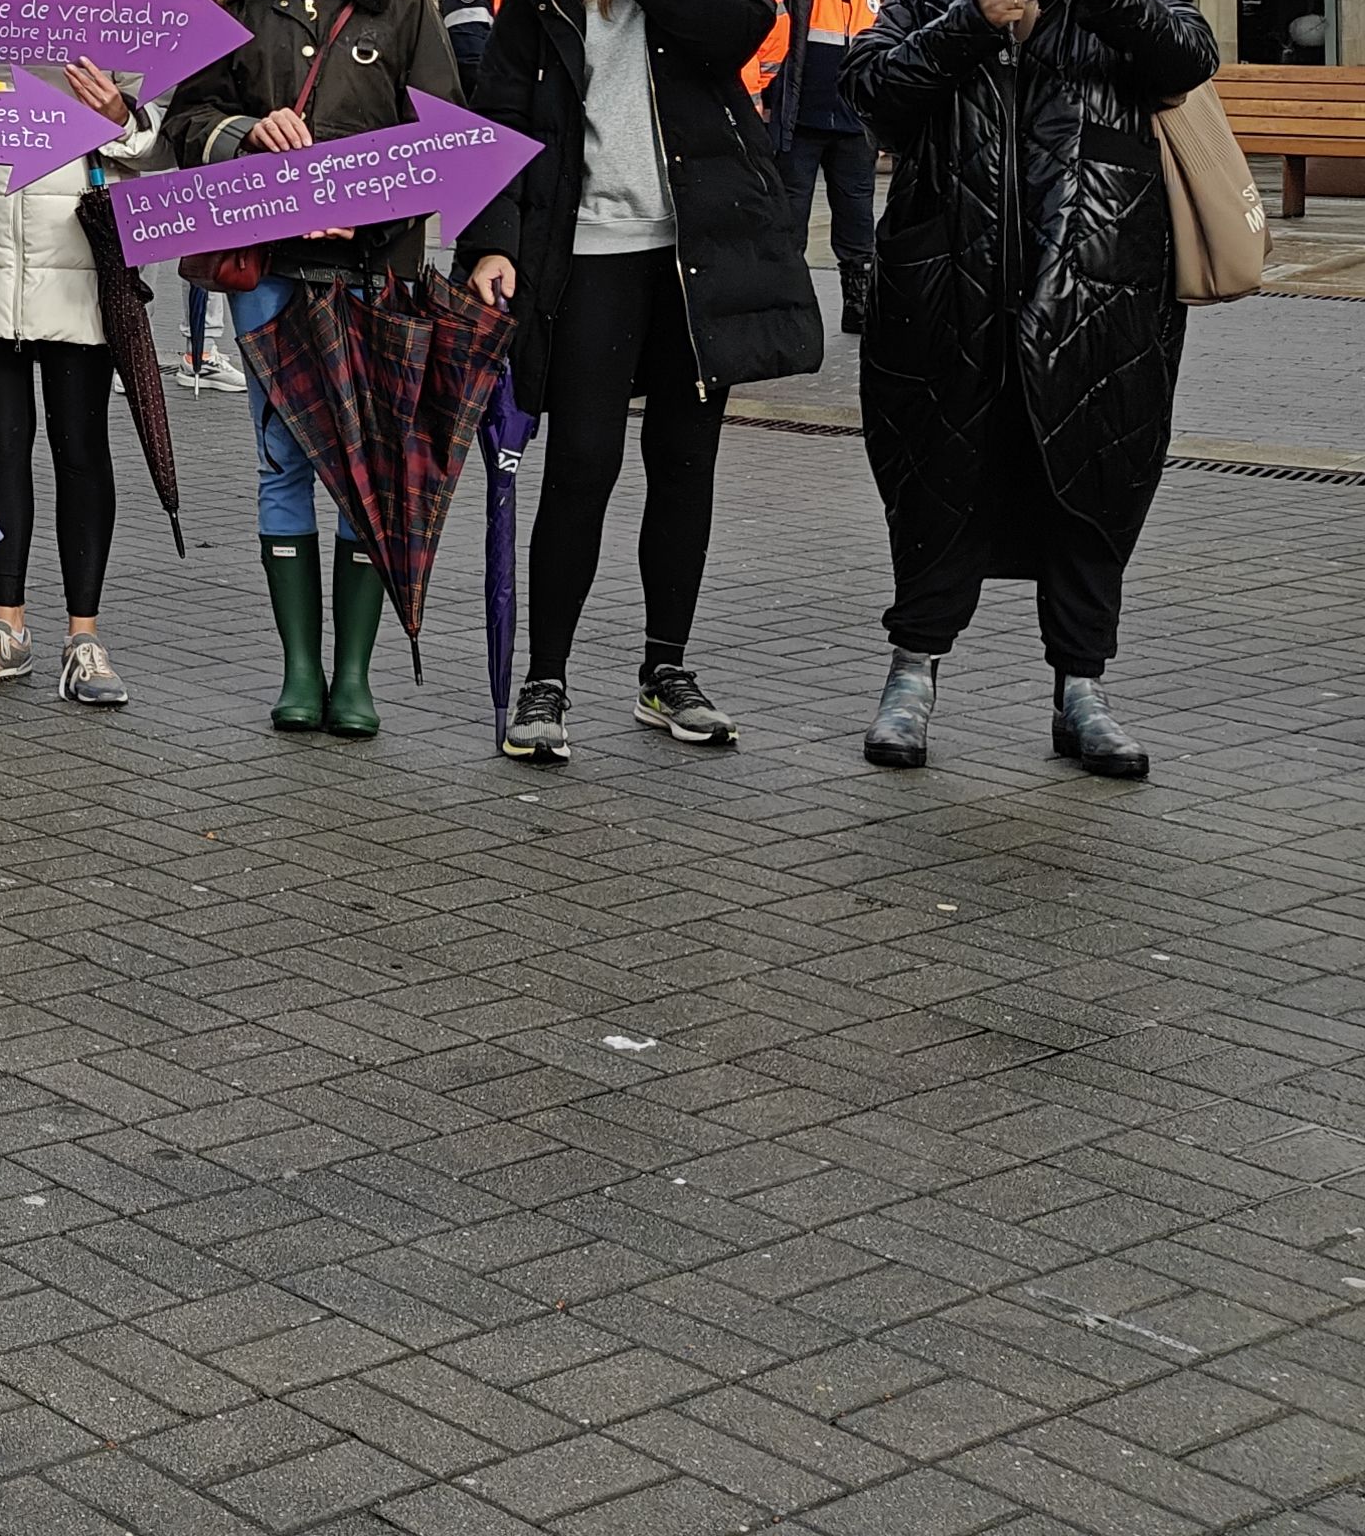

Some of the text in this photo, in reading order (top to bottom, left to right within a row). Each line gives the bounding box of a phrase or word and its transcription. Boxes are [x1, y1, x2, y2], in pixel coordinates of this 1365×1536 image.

[57, 0, 153, 26] verdad
[161, 9, 189, 27] no
[47, 27, 88, 43] una
[100, 26, 182, 54] mujer;
[30, 108, 67, 124] un
[126, 126, 498, 215] La violencia de género comienza
[132, 160, 445, 243] donde termina el respeto.
